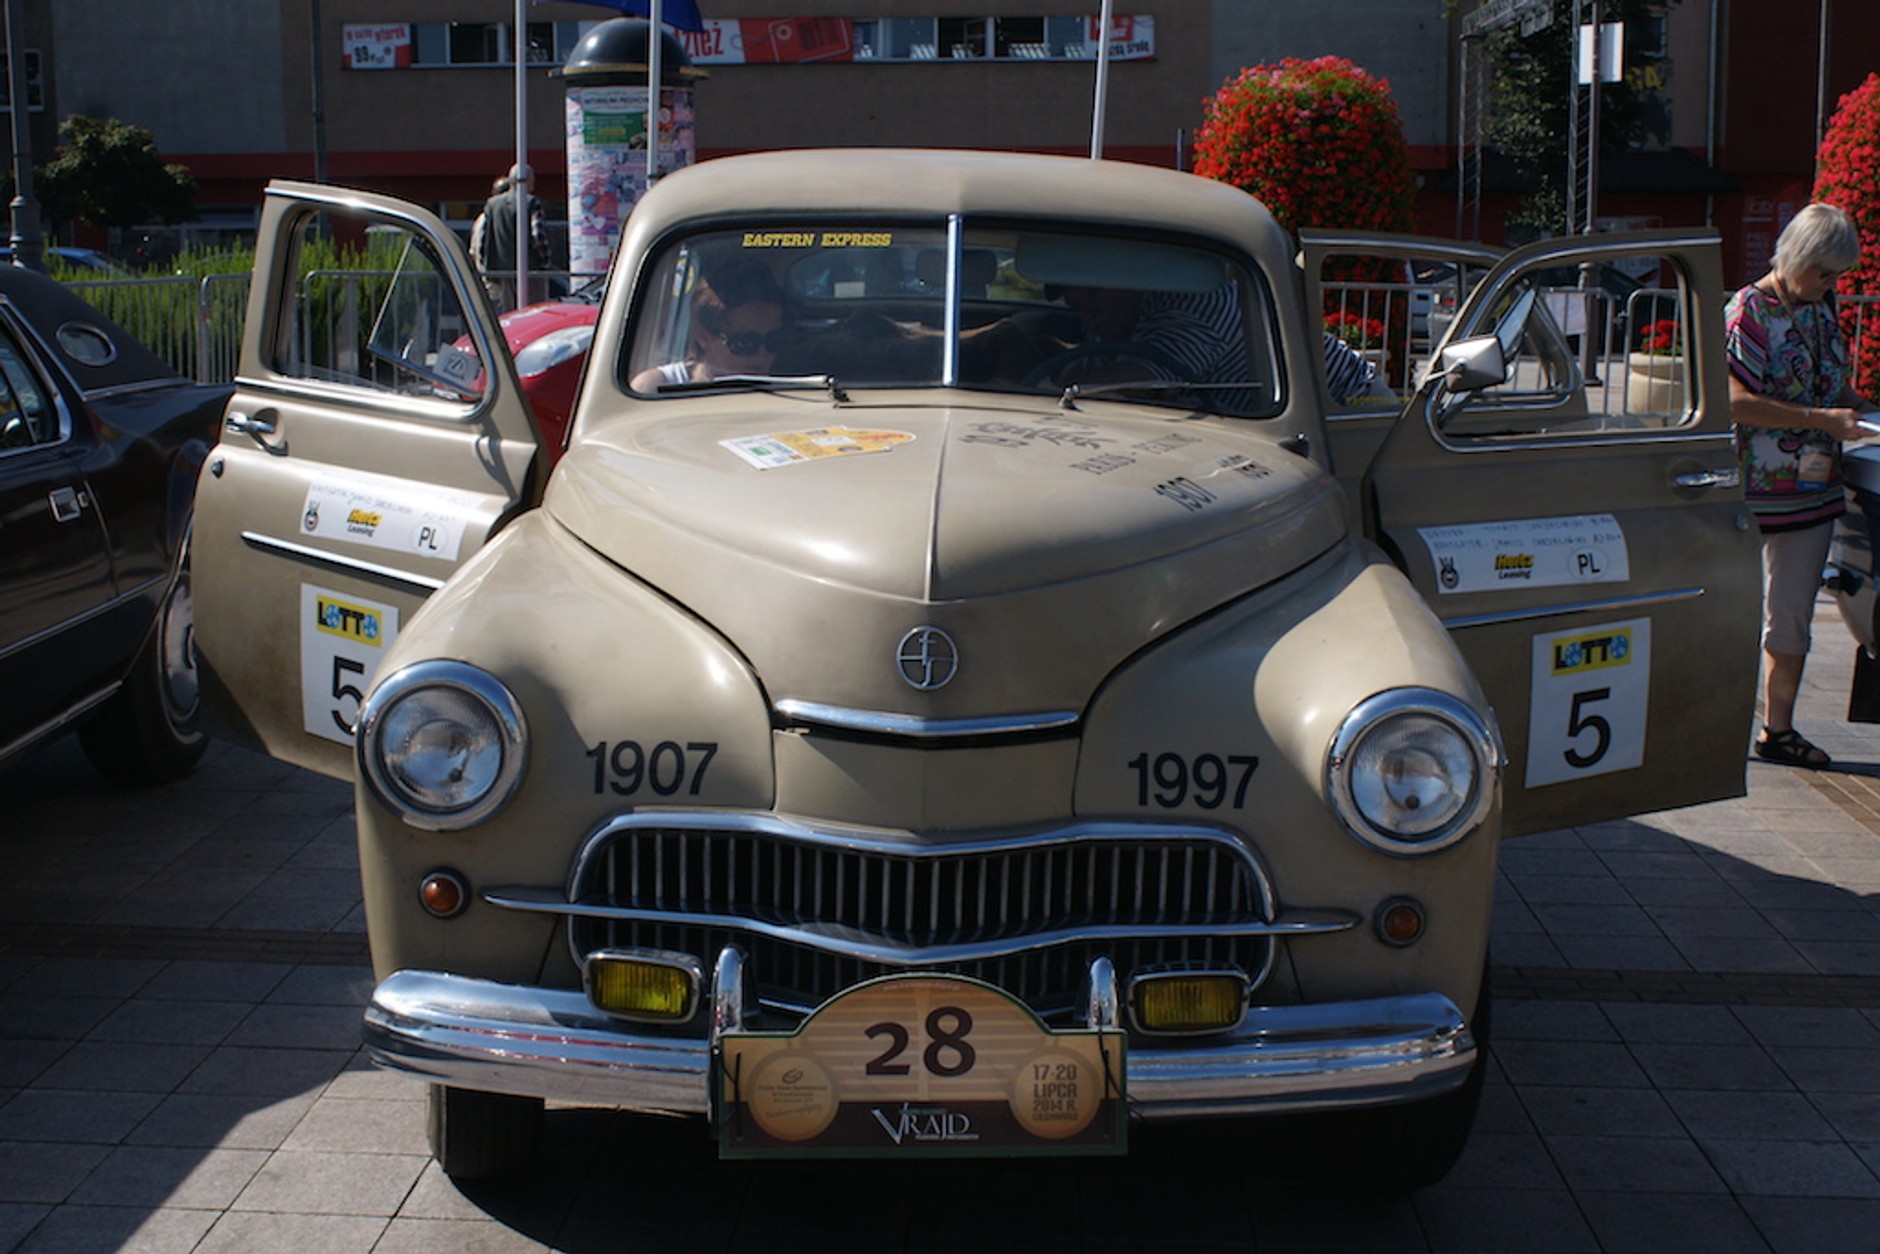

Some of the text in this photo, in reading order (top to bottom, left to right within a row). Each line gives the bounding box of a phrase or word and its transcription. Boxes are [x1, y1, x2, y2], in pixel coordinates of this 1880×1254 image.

[742, 232, 892, 247] EASTERN EXPRESS
[418, 526, 437, 550] PL
[1498, 568, 1532, 580] Leasing
[1577, 552, 1601, 575] PL
[317, 601, 379, 640] LOTTO
[1554, 633, 1629, 670] LOTTO
[330, 655, 365, 736] 5
[1563, 686, 1612, 769] 5
[585, 739, 719, 797] 1907
[1127, 751, 1260, 811] 1997
[863, 1005, 977, 1078] 28
[1033, 1082, 1078, 1099] LIPCA
